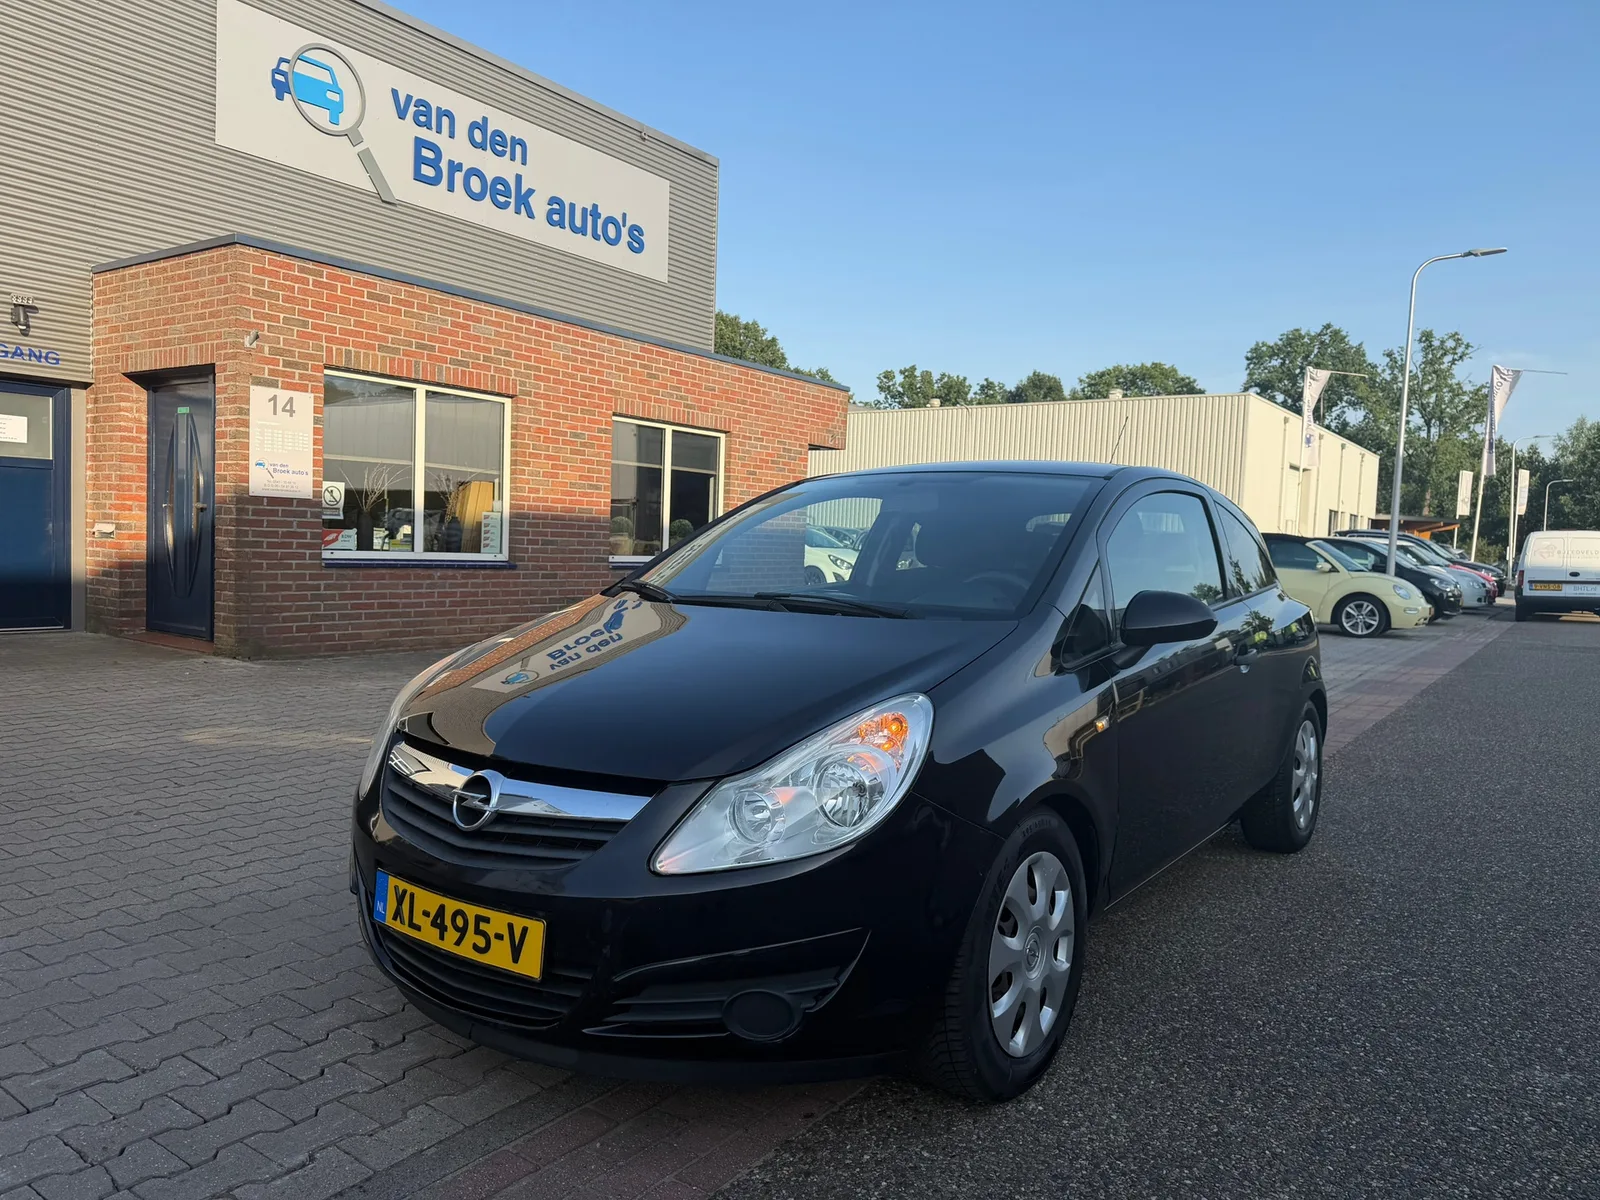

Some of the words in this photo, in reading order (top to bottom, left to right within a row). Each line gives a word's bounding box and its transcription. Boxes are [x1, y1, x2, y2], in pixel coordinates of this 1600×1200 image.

[391, 88, 456, 139] van
[468, 116, 527, 165] den
[413, 136, 536, 219] Broek
[546, 196, 645, 254] auto's
[268, 394, 296, 418] 14
[376, 900, 385, 914] NL
[391, 885, 529, 964] XL-495-V
